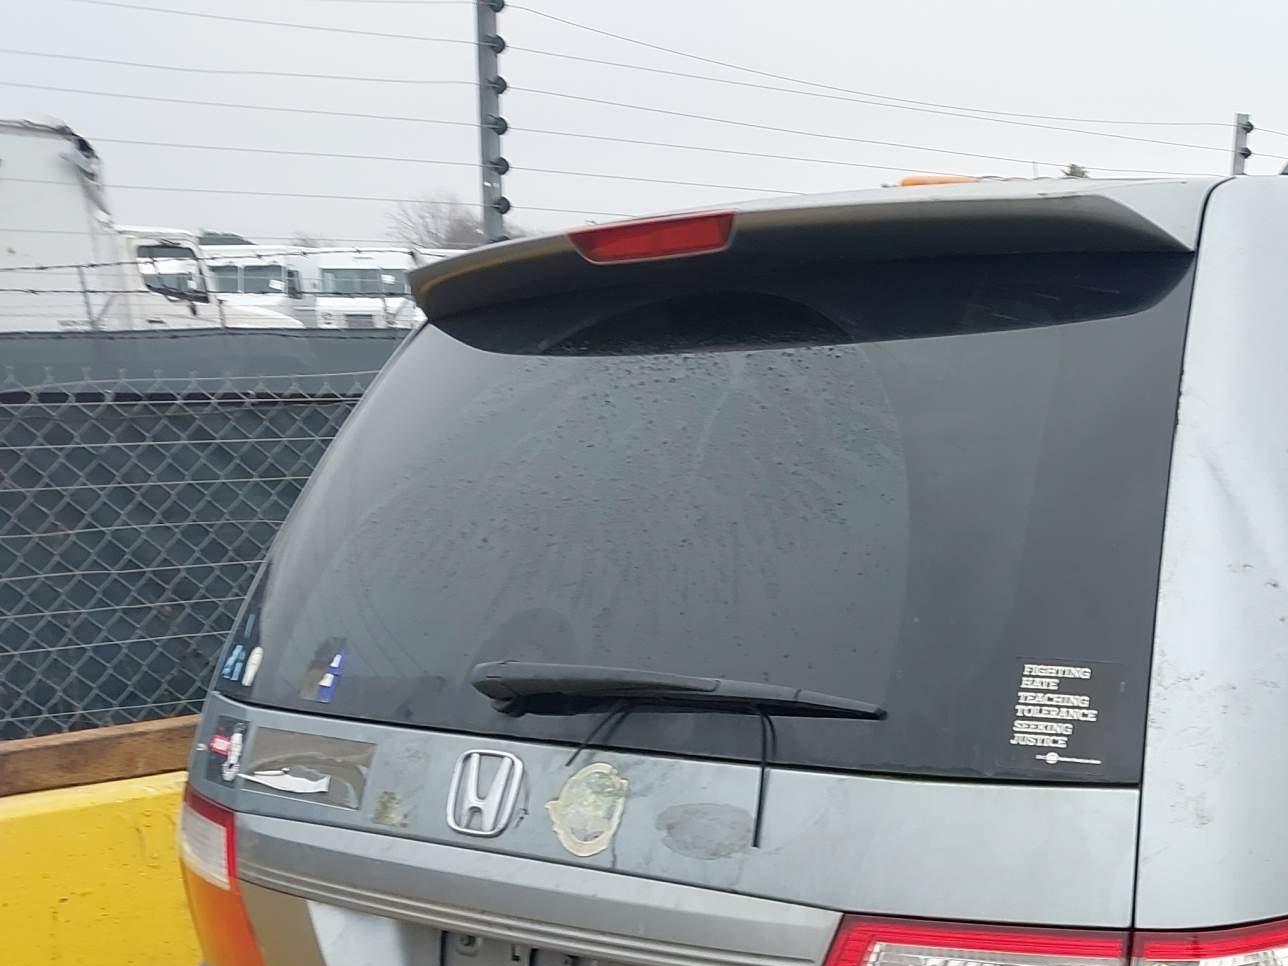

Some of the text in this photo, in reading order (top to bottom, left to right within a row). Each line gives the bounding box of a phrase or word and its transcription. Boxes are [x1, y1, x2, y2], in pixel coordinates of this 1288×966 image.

[1023, 664, 1092, 679] FIGHTING
[1020, 677, 1060, 690] HATE
[1017, 691, 1090, 707] TEACHING
[1015, 705, 1098, 722] TOLERANCE
[1012, 720, 1073, 735] SEEKING
[1009, 733, 1068, 748] JUSTICE
